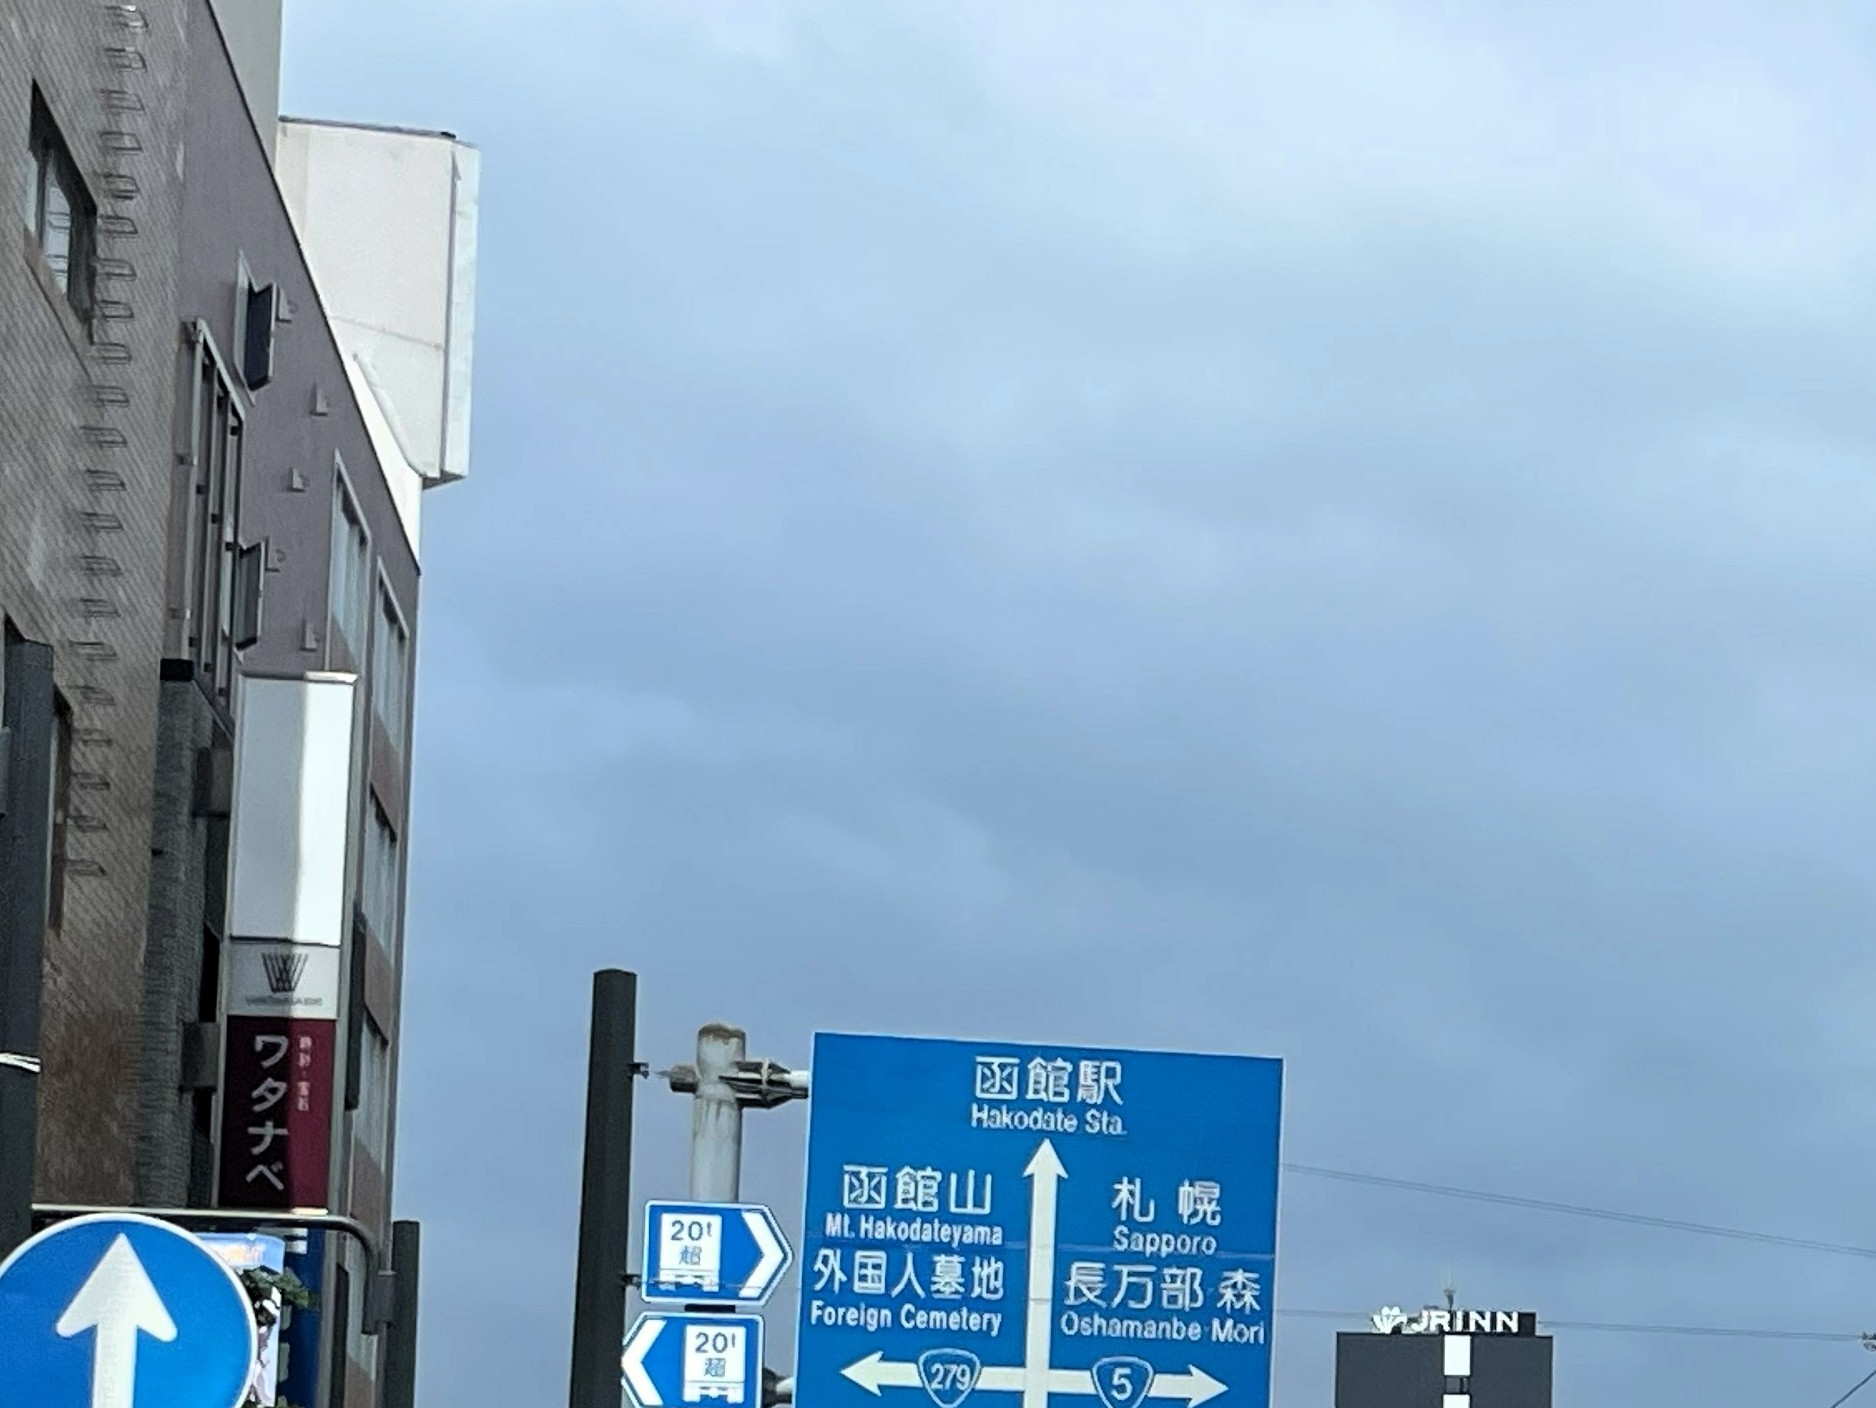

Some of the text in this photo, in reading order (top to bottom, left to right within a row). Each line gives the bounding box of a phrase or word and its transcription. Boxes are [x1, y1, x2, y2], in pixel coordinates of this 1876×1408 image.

[973, 1055, 1123, 1105] 函館駅
[246, 1035, 288, 1190] ワタナベ
[971, 1104, 1127, 1135] Hakodate Sta.
[842, 1165, 993, 1215] 函館山
[825, 1213, 1003, 1246] Mt. Hakodateyama
[1113, 1226, 1217, 1258] Sapporo
[678, 1246, 702, 1266] 超
[813, 1248, 1004, 1300] 外国人墓地
[1064, 1262, 1262, 1314] 長万部 森
[811, 1302, 1002, 1337] Foreign Cemetery
[1061, 1313, 1265, 1345] Oshamanbe Mori
[703, 1357, 726, 1378] 超
[929, 1363, 970, 1389] 279
[1111, 1368, 1132, 1401] 5
